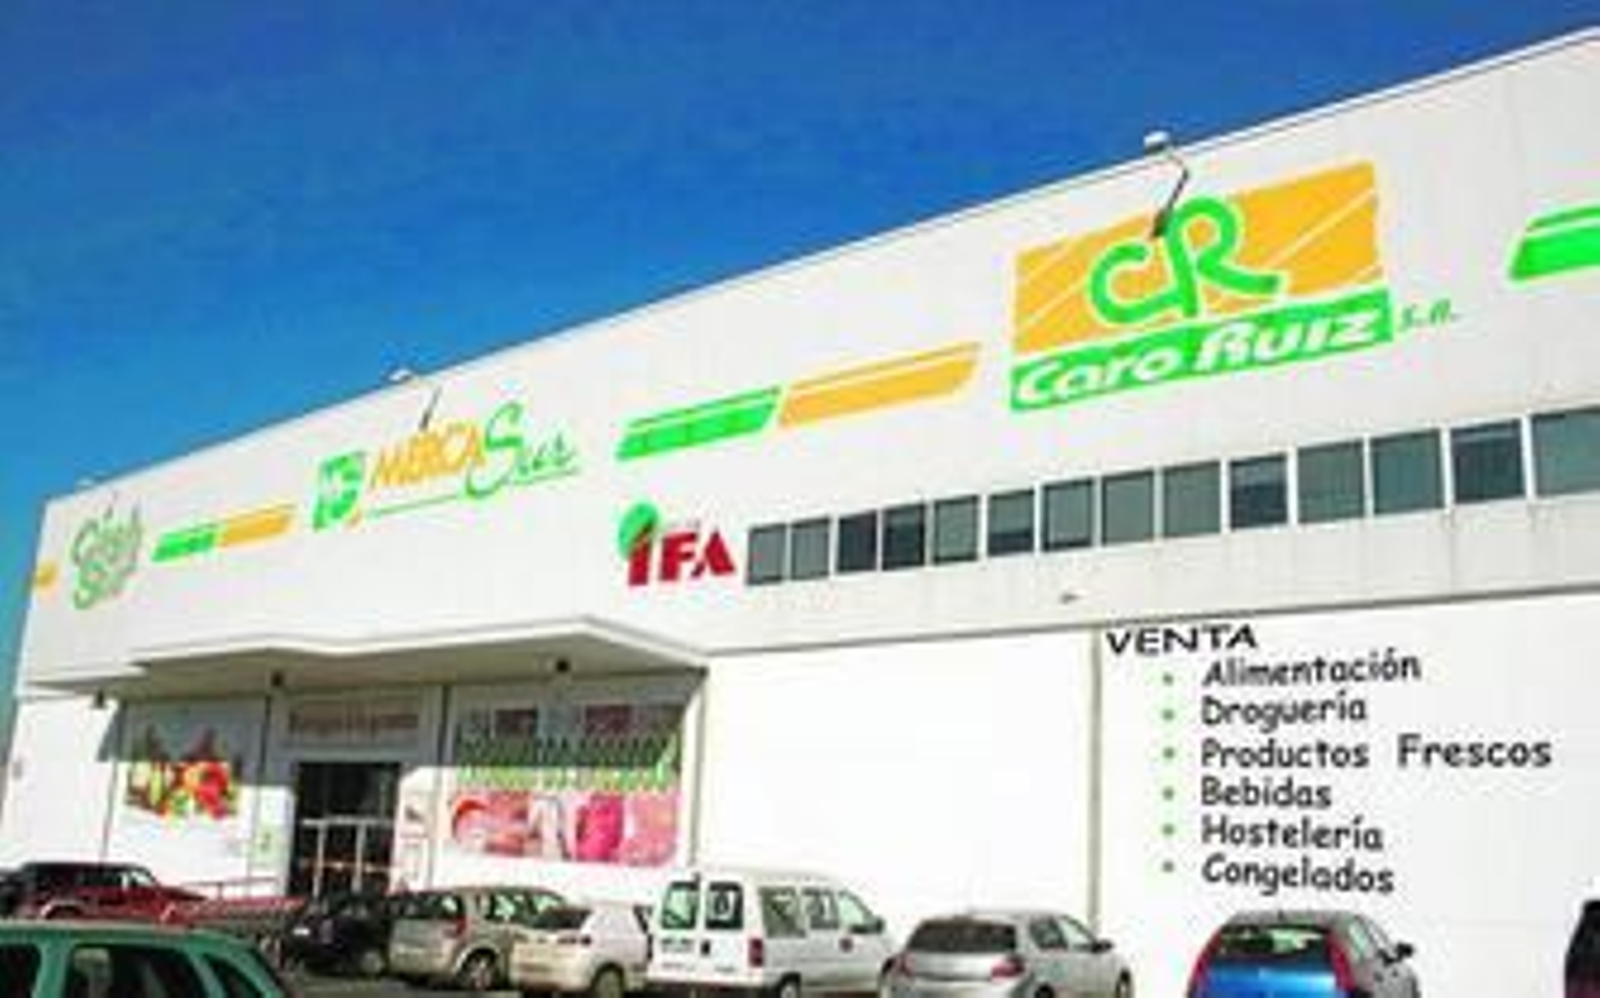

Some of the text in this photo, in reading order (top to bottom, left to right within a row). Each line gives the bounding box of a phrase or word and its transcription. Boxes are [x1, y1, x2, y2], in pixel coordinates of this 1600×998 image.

[1016, 355, 1183, 404] Caro
[1106, 624, 1258, 654] VENTA
[1202, 648, 1422, 686] Alimentación
[1201, 691, 1367, 732] Droguería
[1201, 733, 1553, 768] Productos Frescos
[1201, 777, 1332, 808] Bebidas
[1201, 815, 1384, 850] Hostelería
[1201, 854, 1395, 895] Congelados
